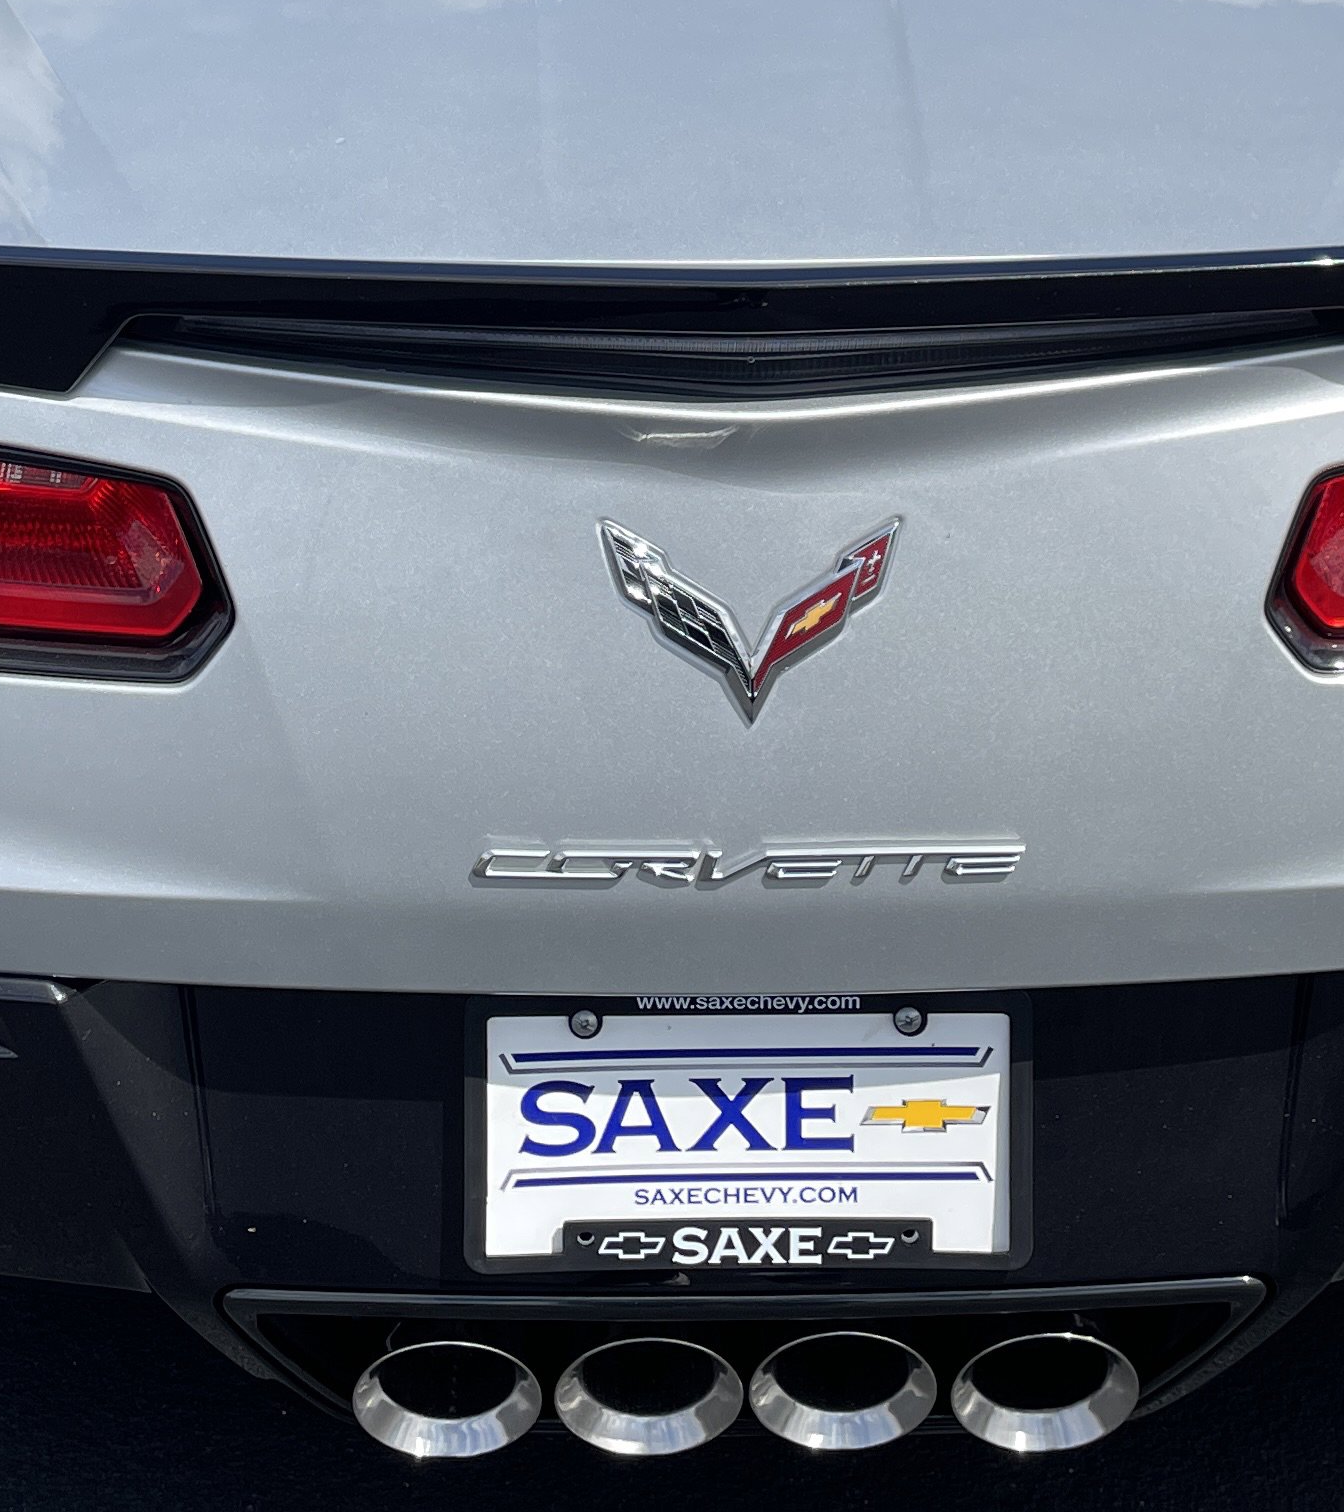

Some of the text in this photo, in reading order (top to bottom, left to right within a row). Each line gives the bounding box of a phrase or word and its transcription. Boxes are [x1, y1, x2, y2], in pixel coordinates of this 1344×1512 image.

[469, 843, 1026, 882] CORVETTE
[636, 995, 861, 1014] www.saxechevy.com
[518, 1074, 855, 1157] SAXE
[634, 1186, 859, 1206] SAXECHEVY.COM
[671, 1226, 823, 1266] SAXE
